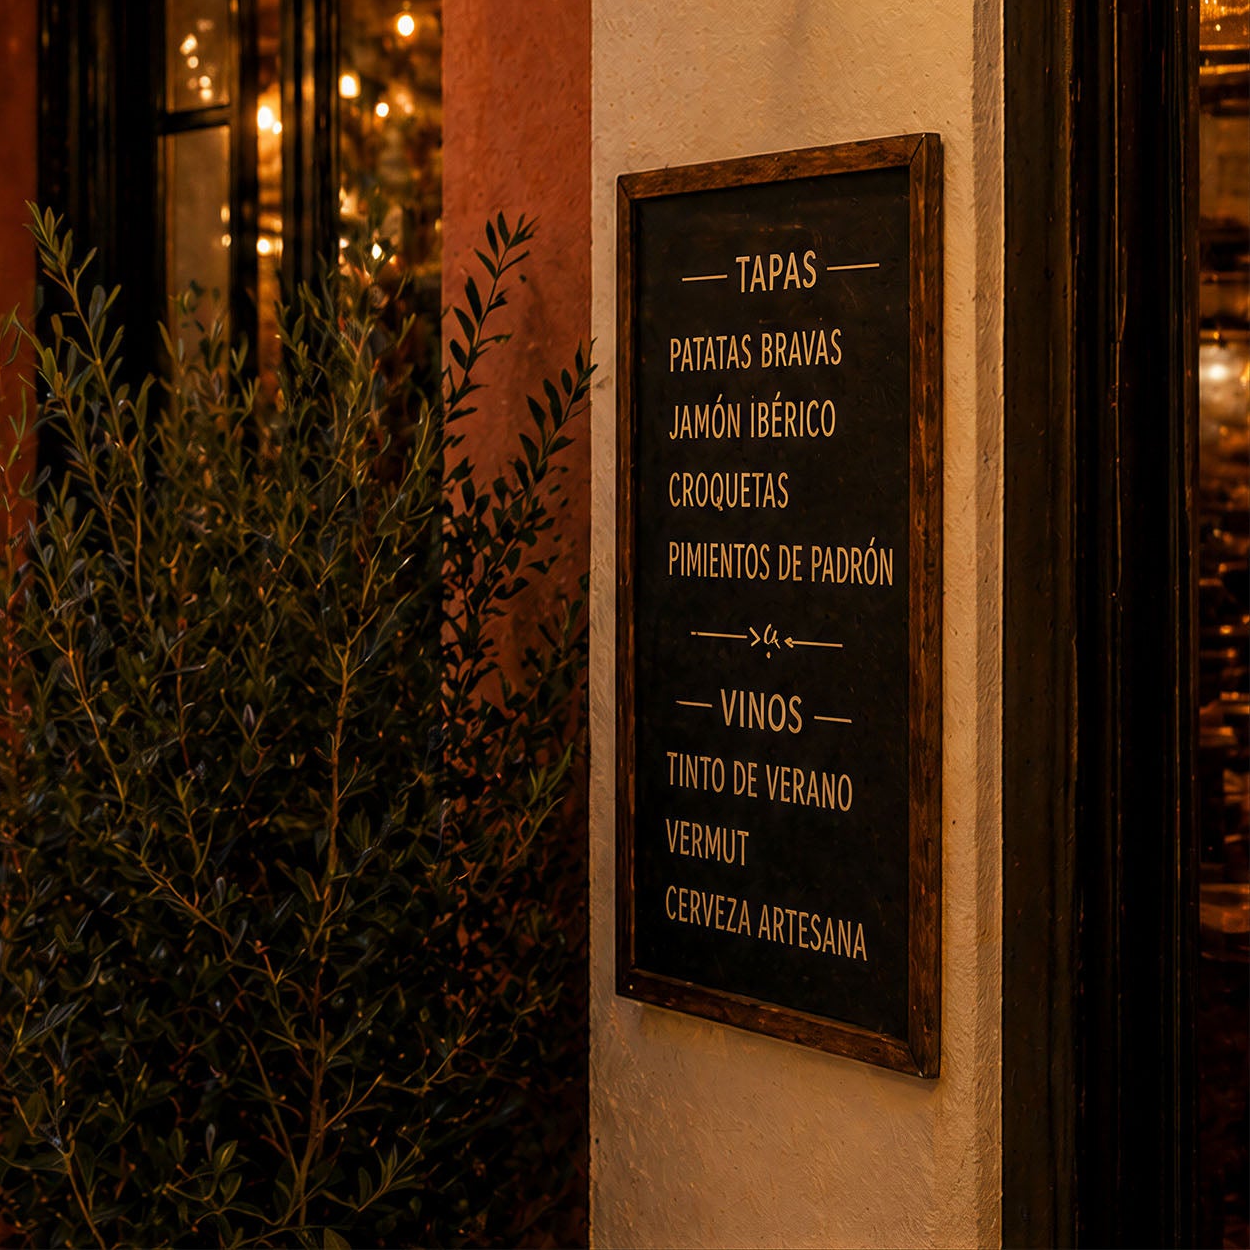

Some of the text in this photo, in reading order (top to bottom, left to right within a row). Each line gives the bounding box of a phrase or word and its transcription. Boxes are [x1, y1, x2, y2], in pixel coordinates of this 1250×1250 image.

[735, 249, 817, 293] TAPAS
[669, 328, 842, 372] PATATAS BRAVAS
[669, 393, 741, 440] JAMÓN
[669, 471, 789, 511] CROQUETAS
[669, 537, 893, 586] PIMIENTOS DE PADRÓN
[720, 688, 803, 734] VINOS
[666, 751, 853, 812] TINTO DE VERANO
[665, 818, 750, 866] VERMUT
[665, 885, 868, 961] CERVEZA ARTESANA
